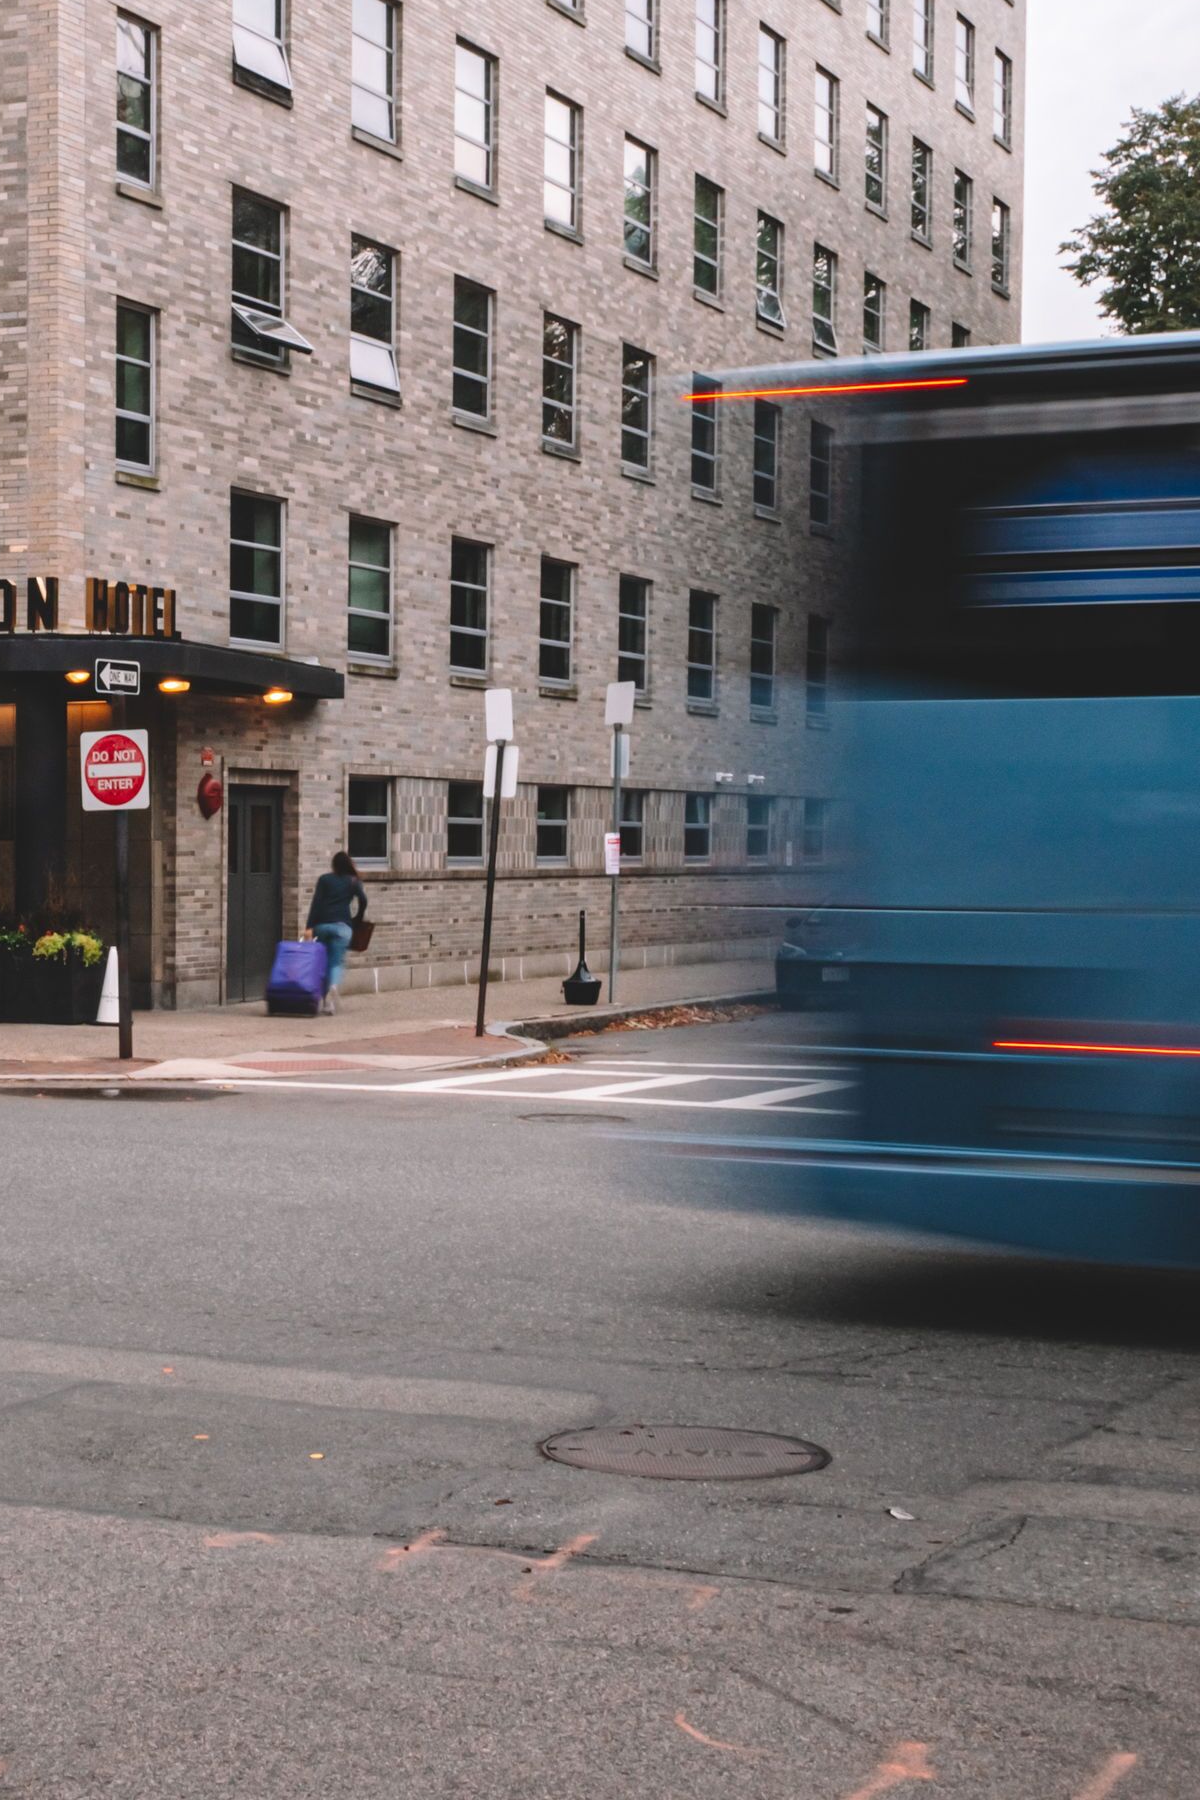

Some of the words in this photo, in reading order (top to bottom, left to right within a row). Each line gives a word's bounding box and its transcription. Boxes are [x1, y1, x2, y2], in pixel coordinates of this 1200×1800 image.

[86, 577, 181, 640] HOTEL
[109, 671, 121, 683] ONE
[124, 672, 136, 684] WAY
[92, 751, 109, 762] DO
[113, 750, 137, 761] NOT
[97, 778, 134, 791] ENTER
